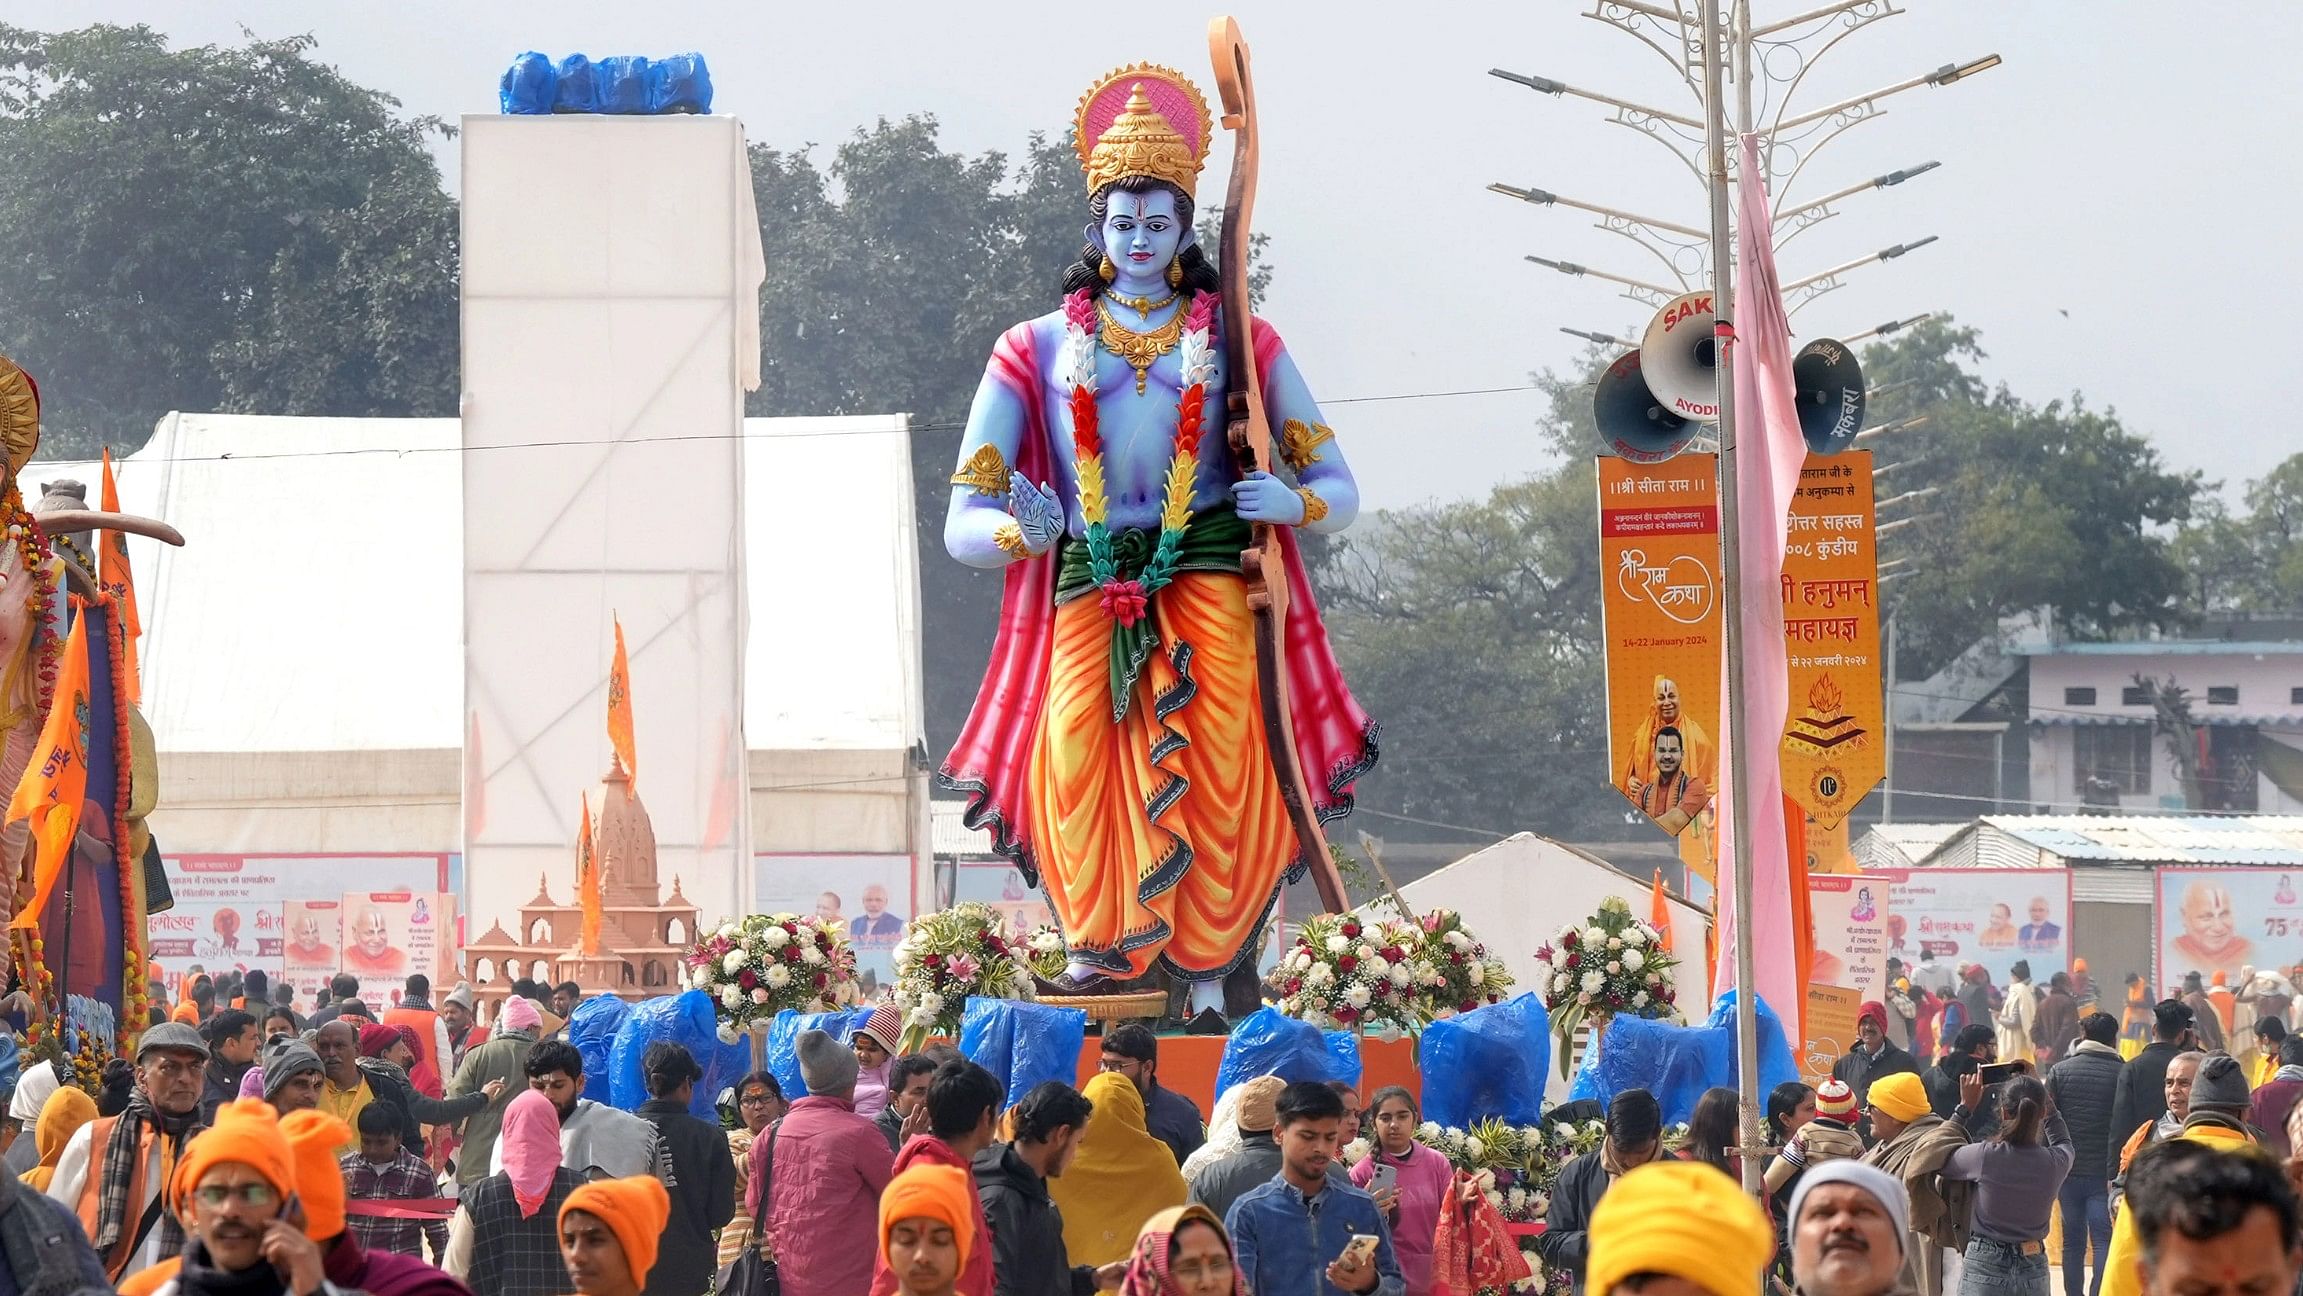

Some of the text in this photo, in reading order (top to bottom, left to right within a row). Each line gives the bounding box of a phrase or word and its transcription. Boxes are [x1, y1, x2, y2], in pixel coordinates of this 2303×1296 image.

[1664, 298, 1714, 332] SAK
[1830, 386, 1860, 438] मकबरा
[1829, 465, 1841, 479] जी
[1843, 465, 1853, 478] के
[1638, 476, 1665, 494] सीता
[1668, 478, 1690, 493] राम
[1846, 483, 1855, 497] से
[1786, 536, 1858, 561] ००८ कुंडीय
[1660, 585, 1707, 606] कथा
[1800, 579, 1870, 609] हनुमन्
[1784, 616, 1860, 644] महायज्ञ
[1623, 635, 1708, 648] 14-22 January 2024
[1791, 653, 1867, 668] से २२ जनवरी २०२४
[2265, 917, 2289, 937] 75
